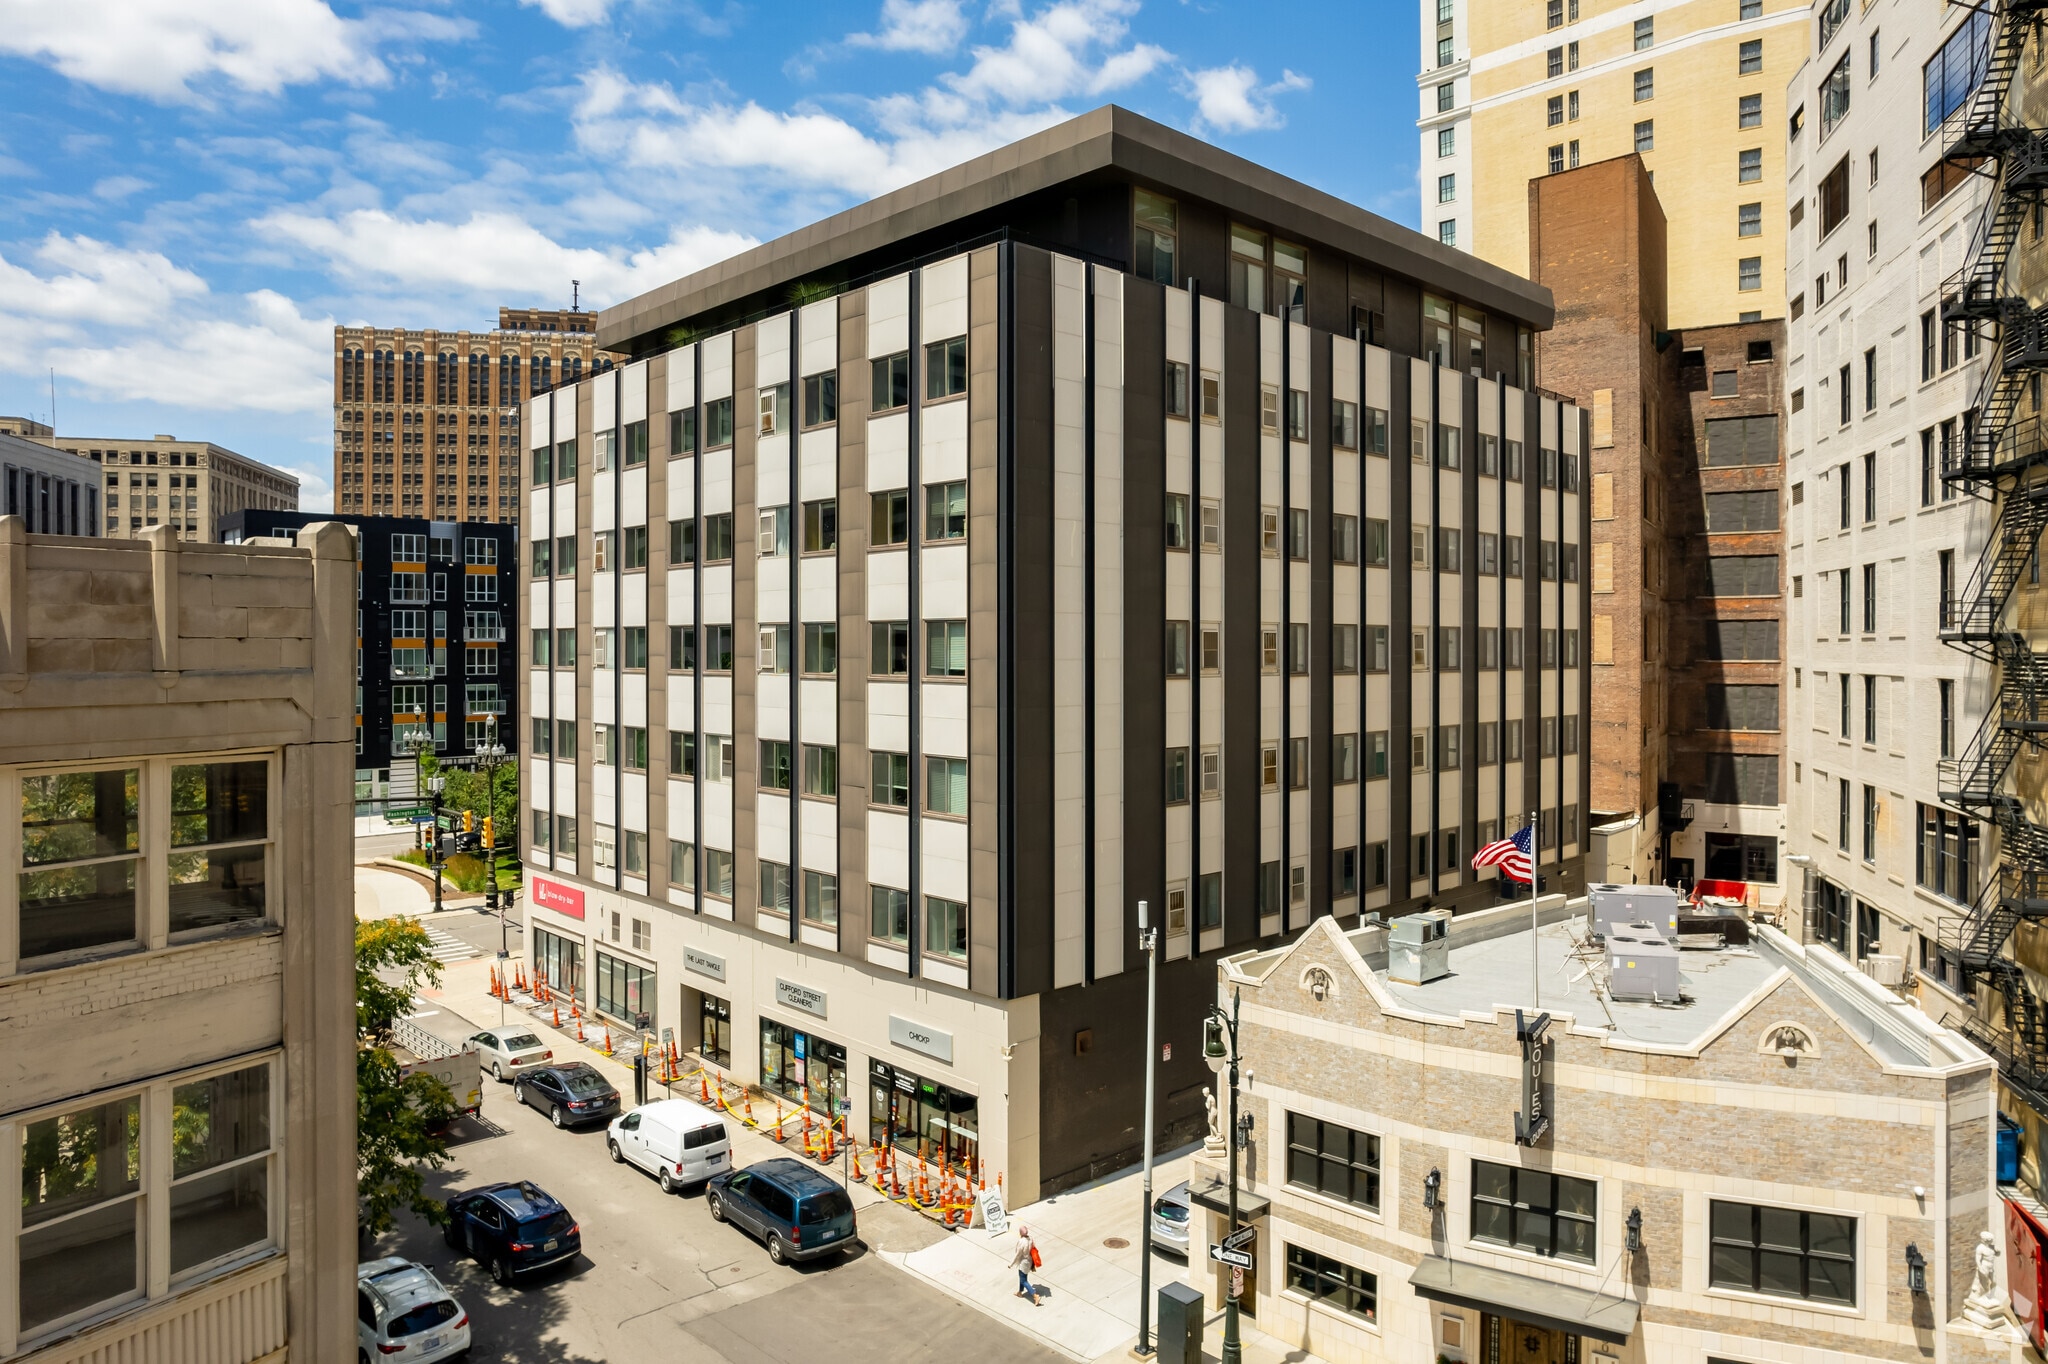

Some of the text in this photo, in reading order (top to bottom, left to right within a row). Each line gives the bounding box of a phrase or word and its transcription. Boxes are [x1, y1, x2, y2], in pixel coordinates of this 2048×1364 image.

[387, 810, 416, 818] Washington
[687, 954, 721, 972] THE LAST TANGLE
[780, 982, 821, 1003] CLIFFORD STREET
[788, 994, 813, 1009] CLEANERS
[908, 1031, 930, 1045] CHICKP
[1530, 1119, 1549, 1147] LOUNGE
[1235, 1255, 1247, 1263] WAY
